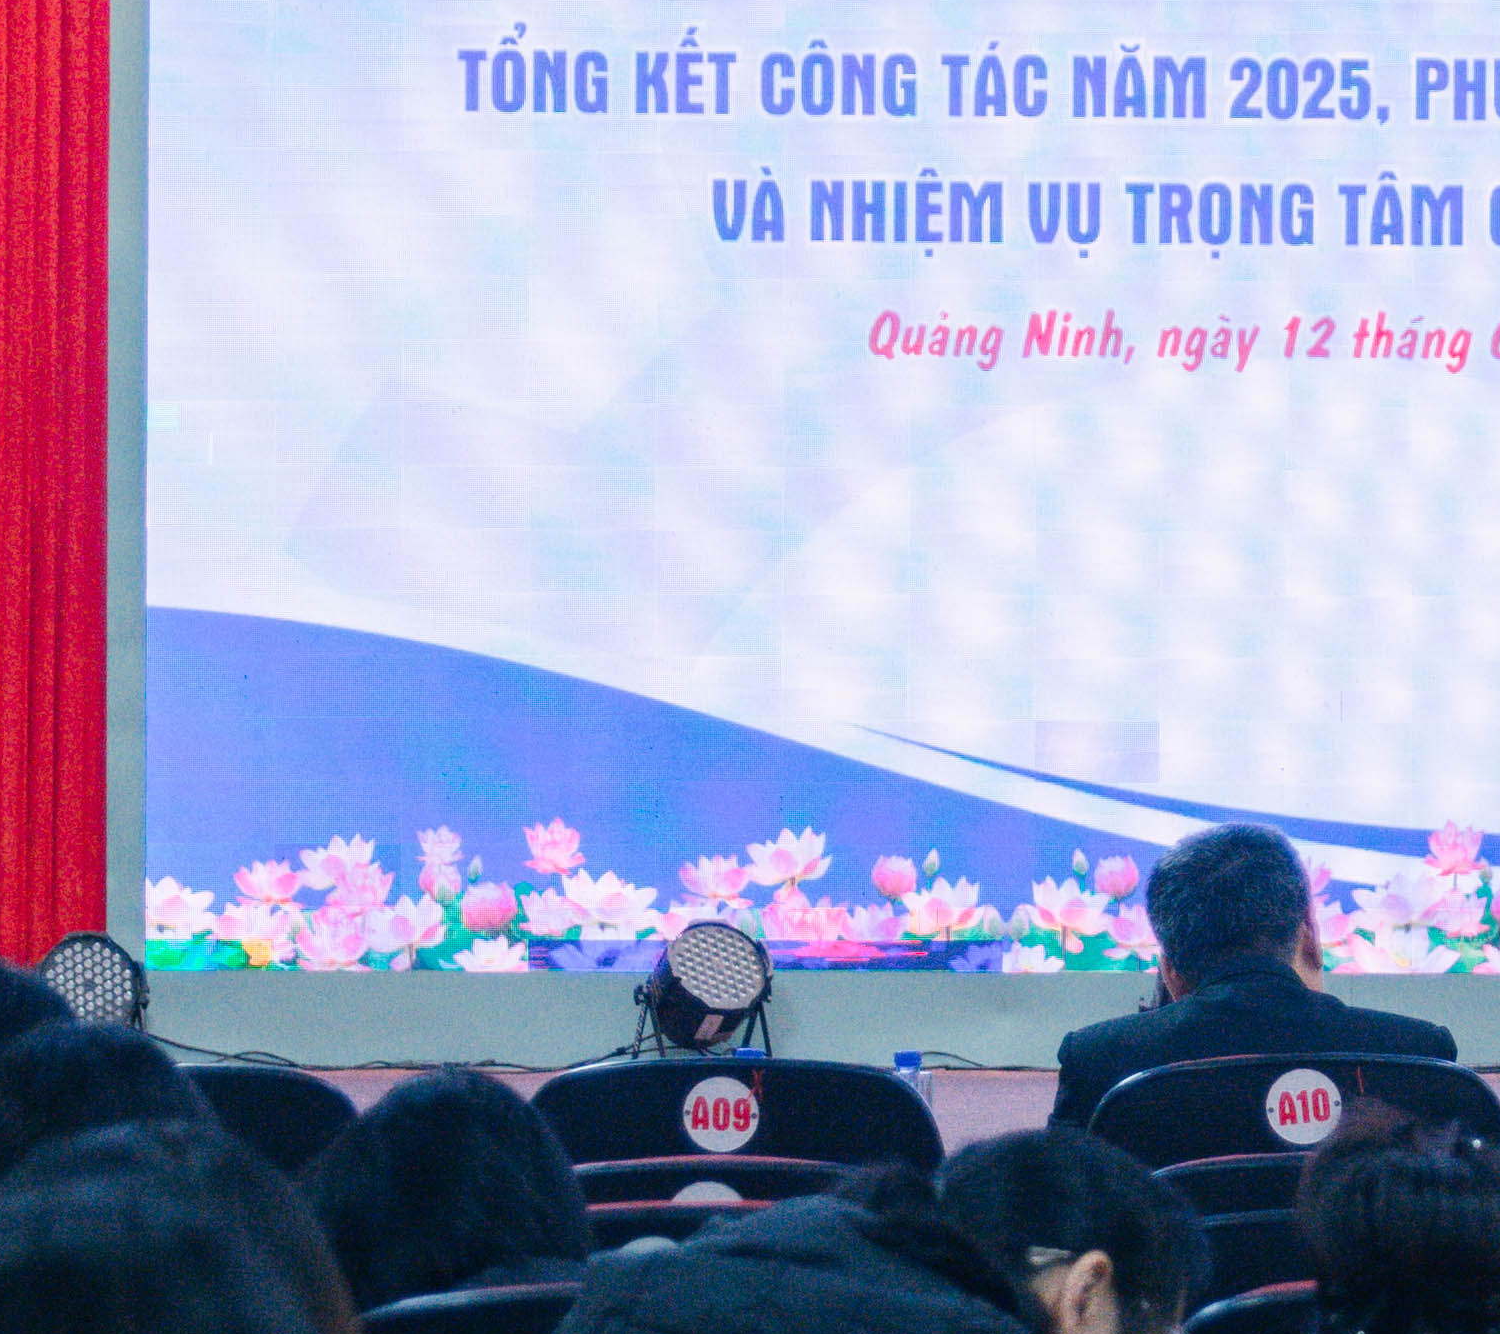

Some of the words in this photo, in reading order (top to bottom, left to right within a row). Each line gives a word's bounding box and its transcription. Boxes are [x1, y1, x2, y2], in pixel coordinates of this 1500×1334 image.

[459, 21, 608, 114] TỔNG
[636, 25, 737, 115] KẾT
[762, 39, 917, 117] CÔNG
[942, 40, 1048, 117] TÁC
[1074, 46, 1205, 118] NĂM
[1231, 59, 1388, 123] 2025,
[714, 167, 784, 241] VÀ
[811, 169, 1002, 256] NHIỆM
[1029, 183, 1100, 257] VỤ
[1126, 184, 1313, 258] TRỌNG
[1339, 172, 1463, 246] TÂM
[871, 311, 1002, 369] Quảng
[1024, 311, 1133, 361] Ninh,
[1158, 314, 1259, 372] ngày
[1285, 317, 1334, 357] 12
[1354, 312, 1471, 374] tháng
[691, 1096, 752, 1132] A09
[1278, 1088, 1330, 1124] A10
